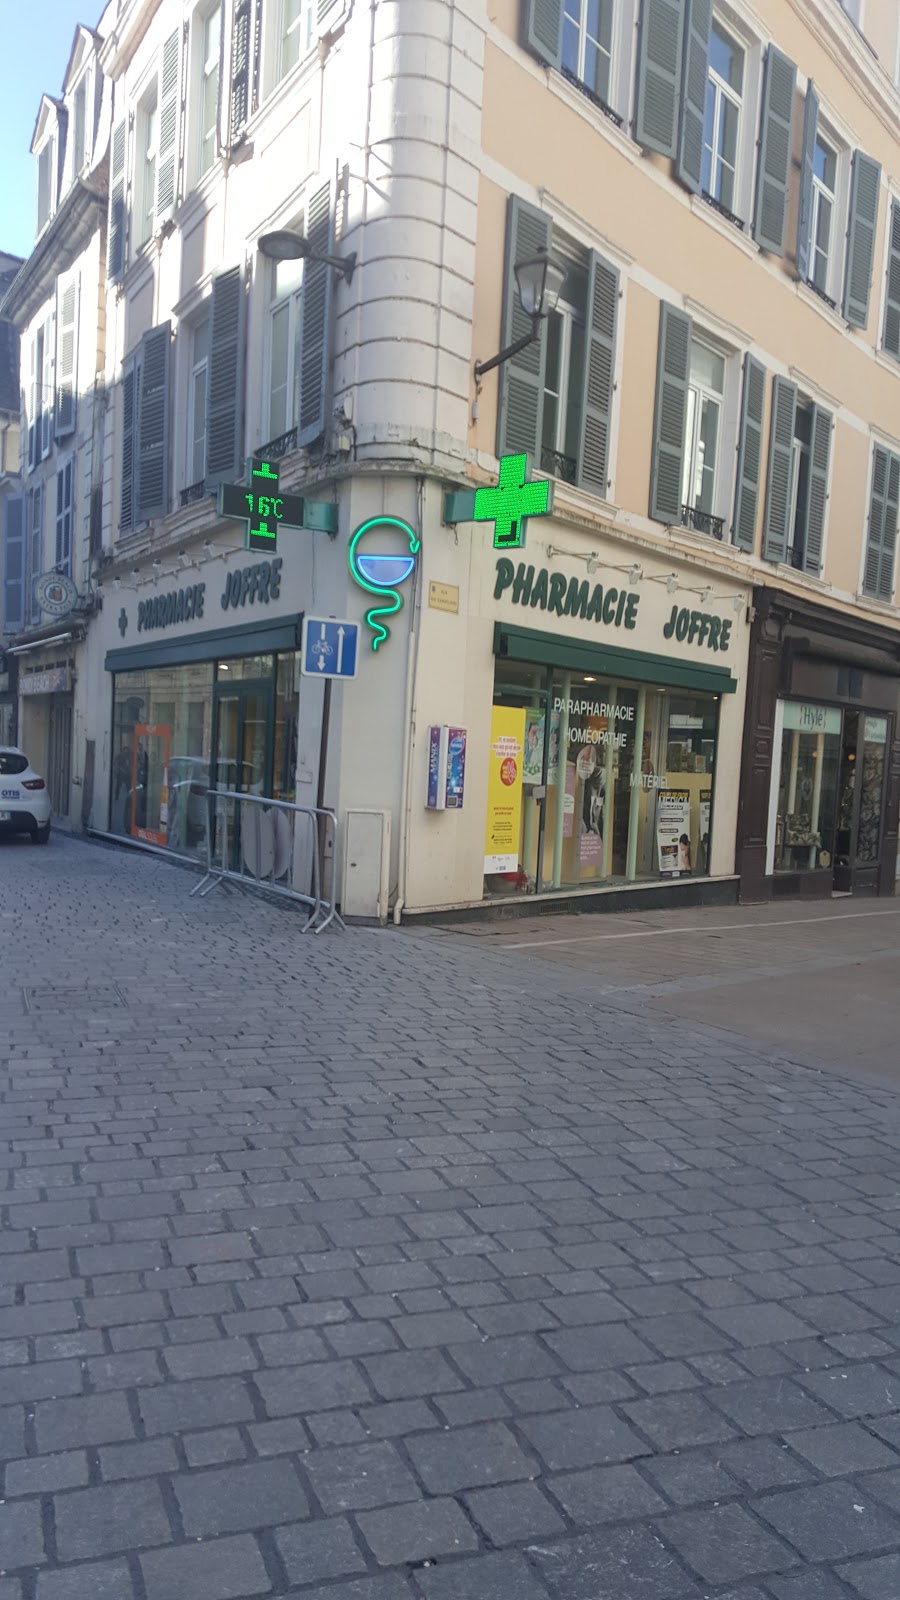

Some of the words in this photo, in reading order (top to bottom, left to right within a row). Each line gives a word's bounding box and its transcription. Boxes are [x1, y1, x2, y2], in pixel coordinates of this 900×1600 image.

[137, 582, 206, 632] PHARMACIE
[221, 557, 283, 610] JOFFRE
[493, 556, 641, 630] PHARMACIE
[662, 604, 733, 653] JOFFRE
[554, 697, 634, 721] PARAPHARMACIE
[565, 726, 627, 747] HOMÉOPATHIE
[430, 742, 438, 773] MANIX
[629, 771, 669, 788] MATÉRIEL
[1, 789, 20, 797] OTIS
